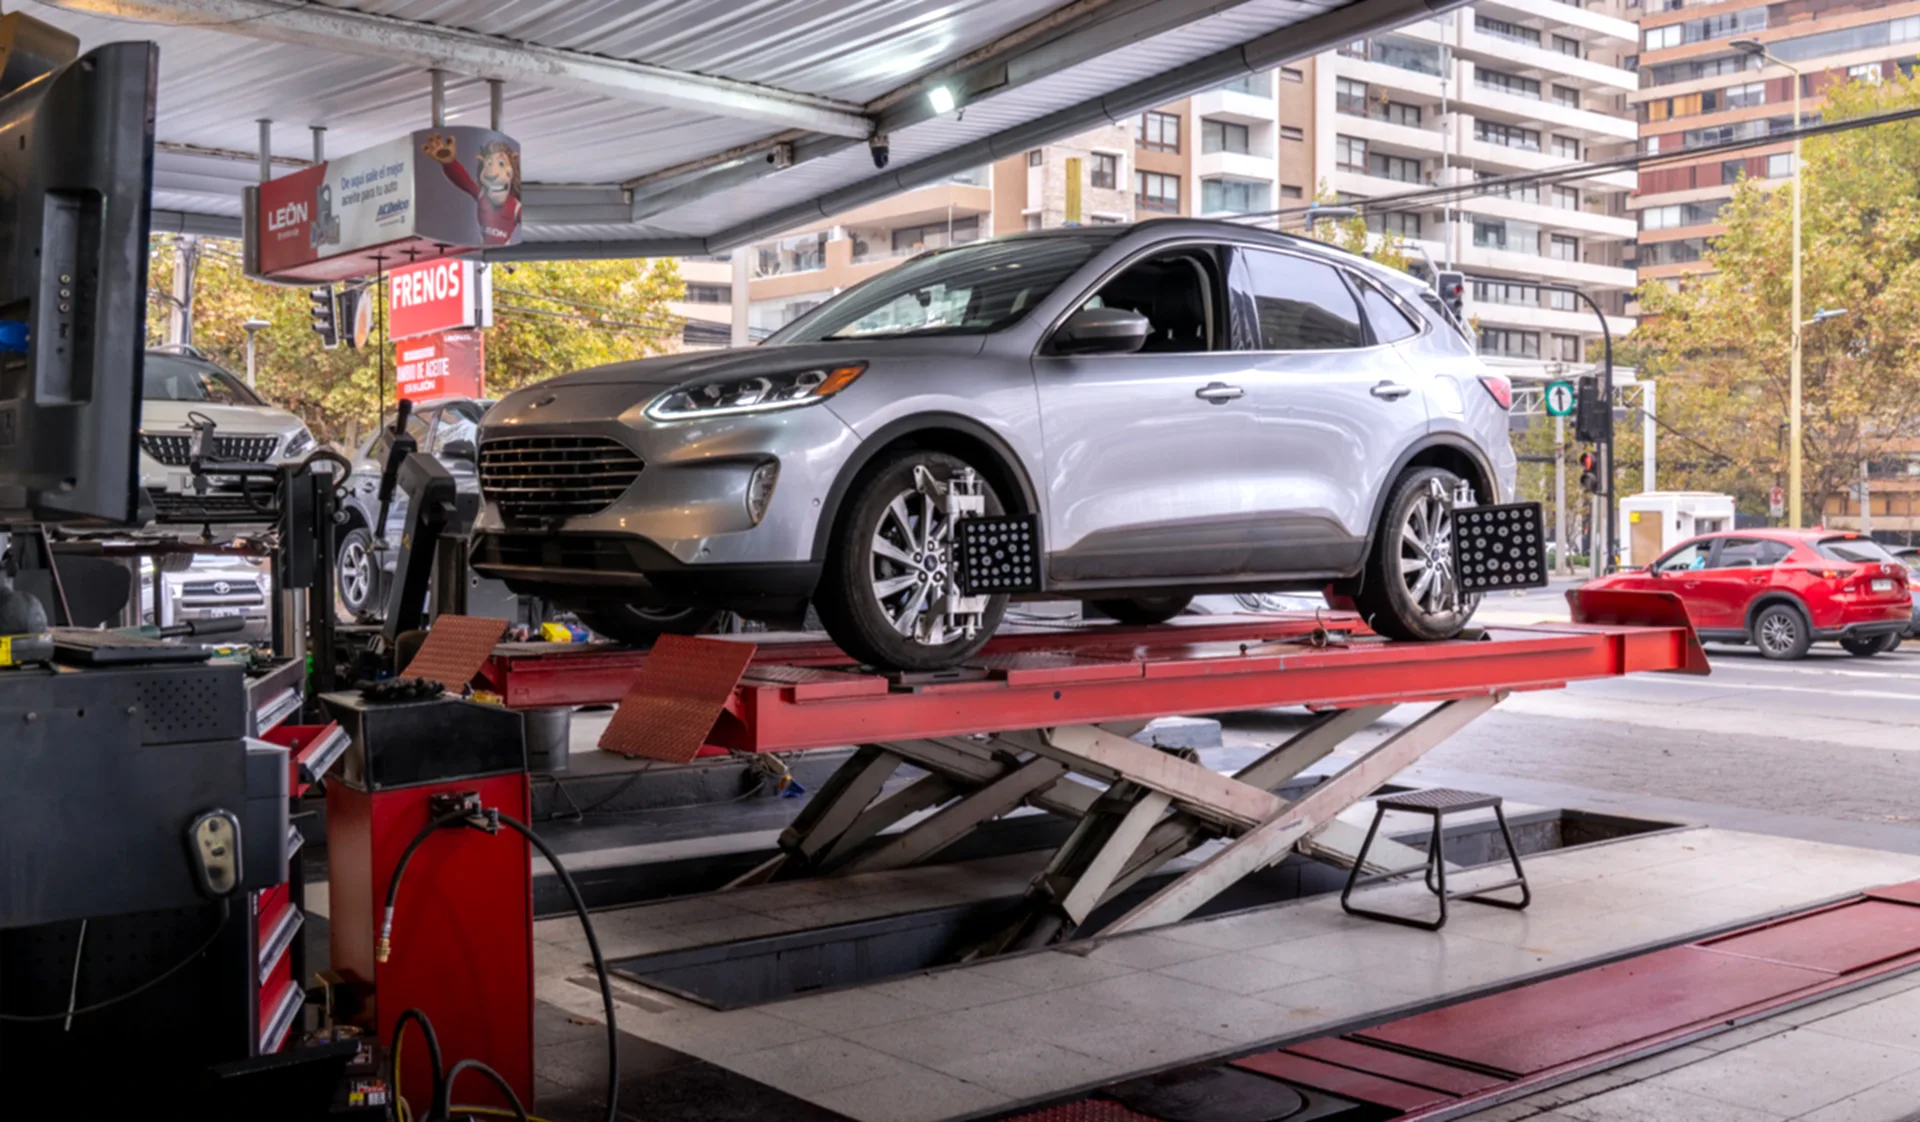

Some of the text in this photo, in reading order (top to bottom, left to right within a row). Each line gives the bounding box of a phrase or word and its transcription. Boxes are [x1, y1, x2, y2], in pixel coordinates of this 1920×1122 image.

[386, 161, 405, 178] mejor
[342, 190, 360, 206] aceite
[361, 187, 375, 204] para
[383, 180, 398, 194] auto
[377, 199, 409, 216] ACDelco
[392, 262, 460, 310] FRENOS
[417, 361, 425, 380] DE
[426, 356, 450, 378] ACEITE
